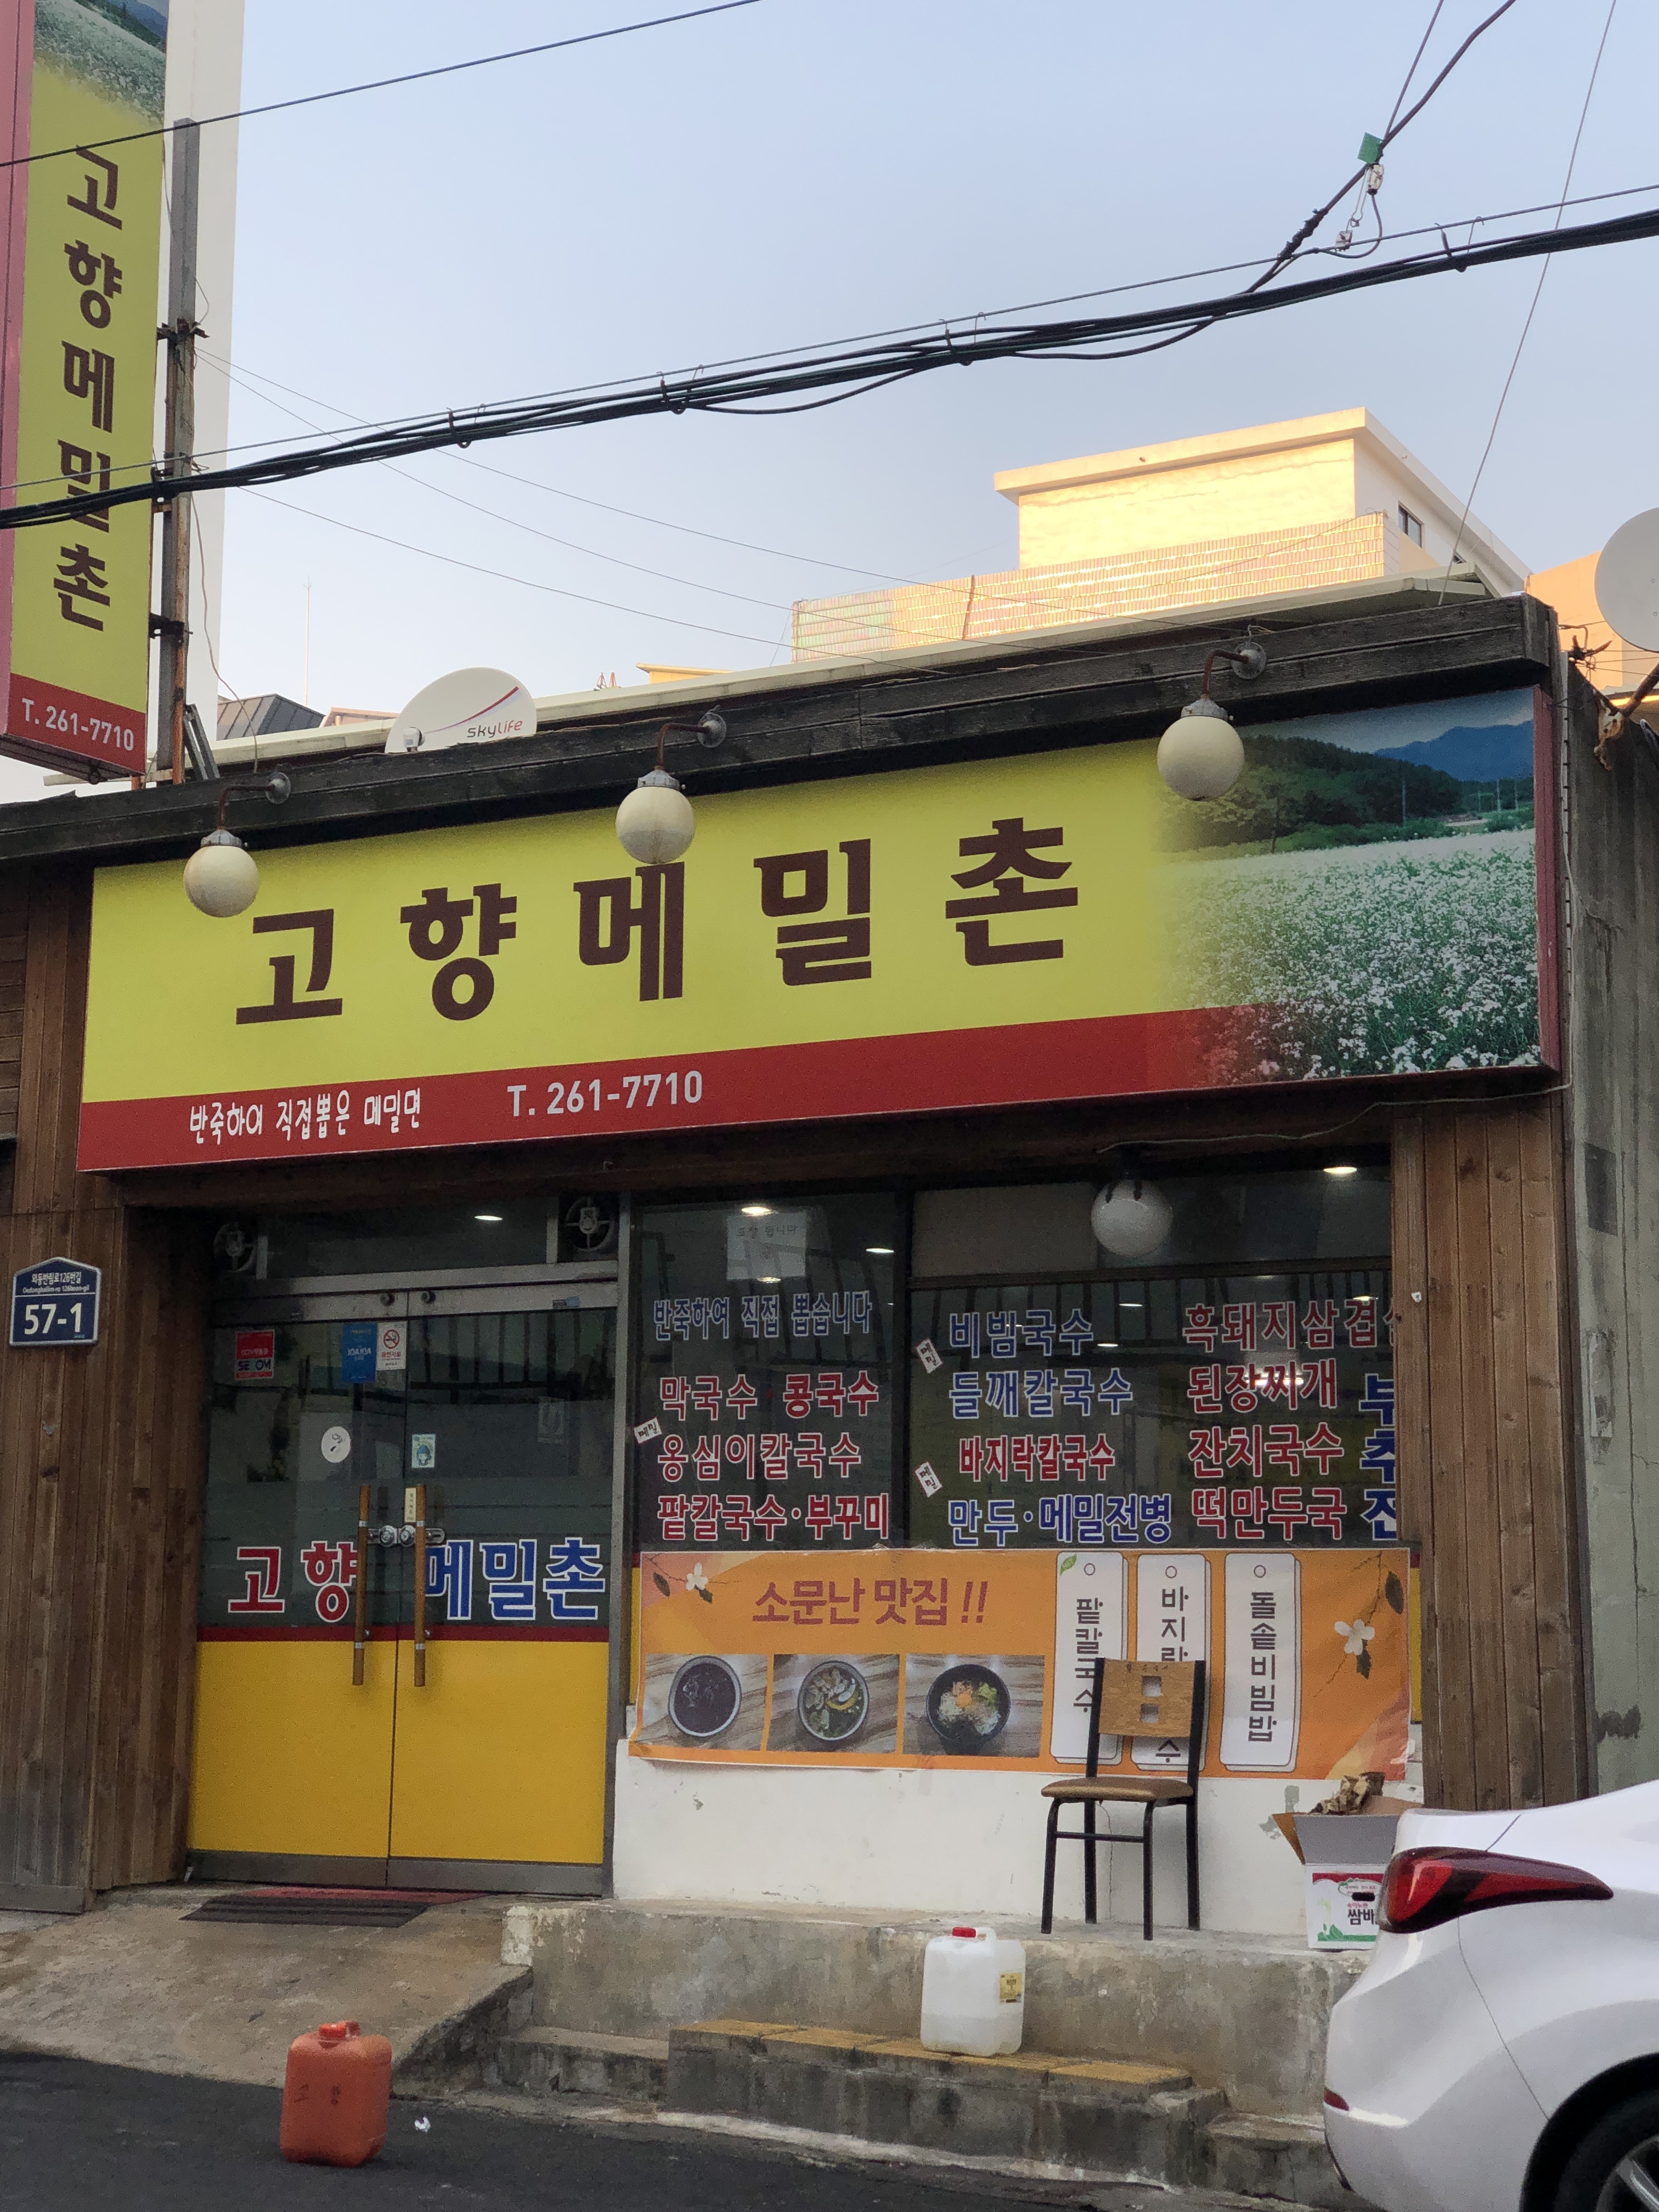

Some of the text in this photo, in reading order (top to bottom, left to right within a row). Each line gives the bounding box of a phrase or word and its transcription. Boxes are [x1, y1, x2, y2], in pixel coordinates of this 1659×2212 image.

[52, 145, 122, 631] 고향메밀촌
[22, 698, 134, 751] T. 261-7710
[467, 720, 523, 738] skylife
[236, 817, 1079, 1025] 고향메밀촌
[190, 1087, 421, 1145] 반죽하여 직접뽑은 메밀면
[507, 1070, 703, 1116] T. 261-7710
[24, 1302, 82, 1335] 57-1
[653, 1290, 873, 1341] 반죽하여 직접 뽑습니다
[950, 1308, 1093, 1358] 비빔국수
[1182, 1298, 1395, 1352] 흑돼지삼겹
[660, 1370, 879, 1421] 막국수 콩국수
[949, 1368, 1133, 1419] 들깨칼국수
[1187, 1358, 1337, 1414] 된장찌개
[658, 1432, 861, 1482] 옹심이칼국수
[960, 1434, 1115, 1482] 바지락칼국수
[1189, 1422, 1344, 1477] 잔치국수
[1192, 1486, 1347, 1541] 떡만두국
[752, 1577, 866, 1625] 소문난
[874, 1577, 948, 1626] 맛집
[1248, 1592, 1277, 1742] 돌솥비빔밥
